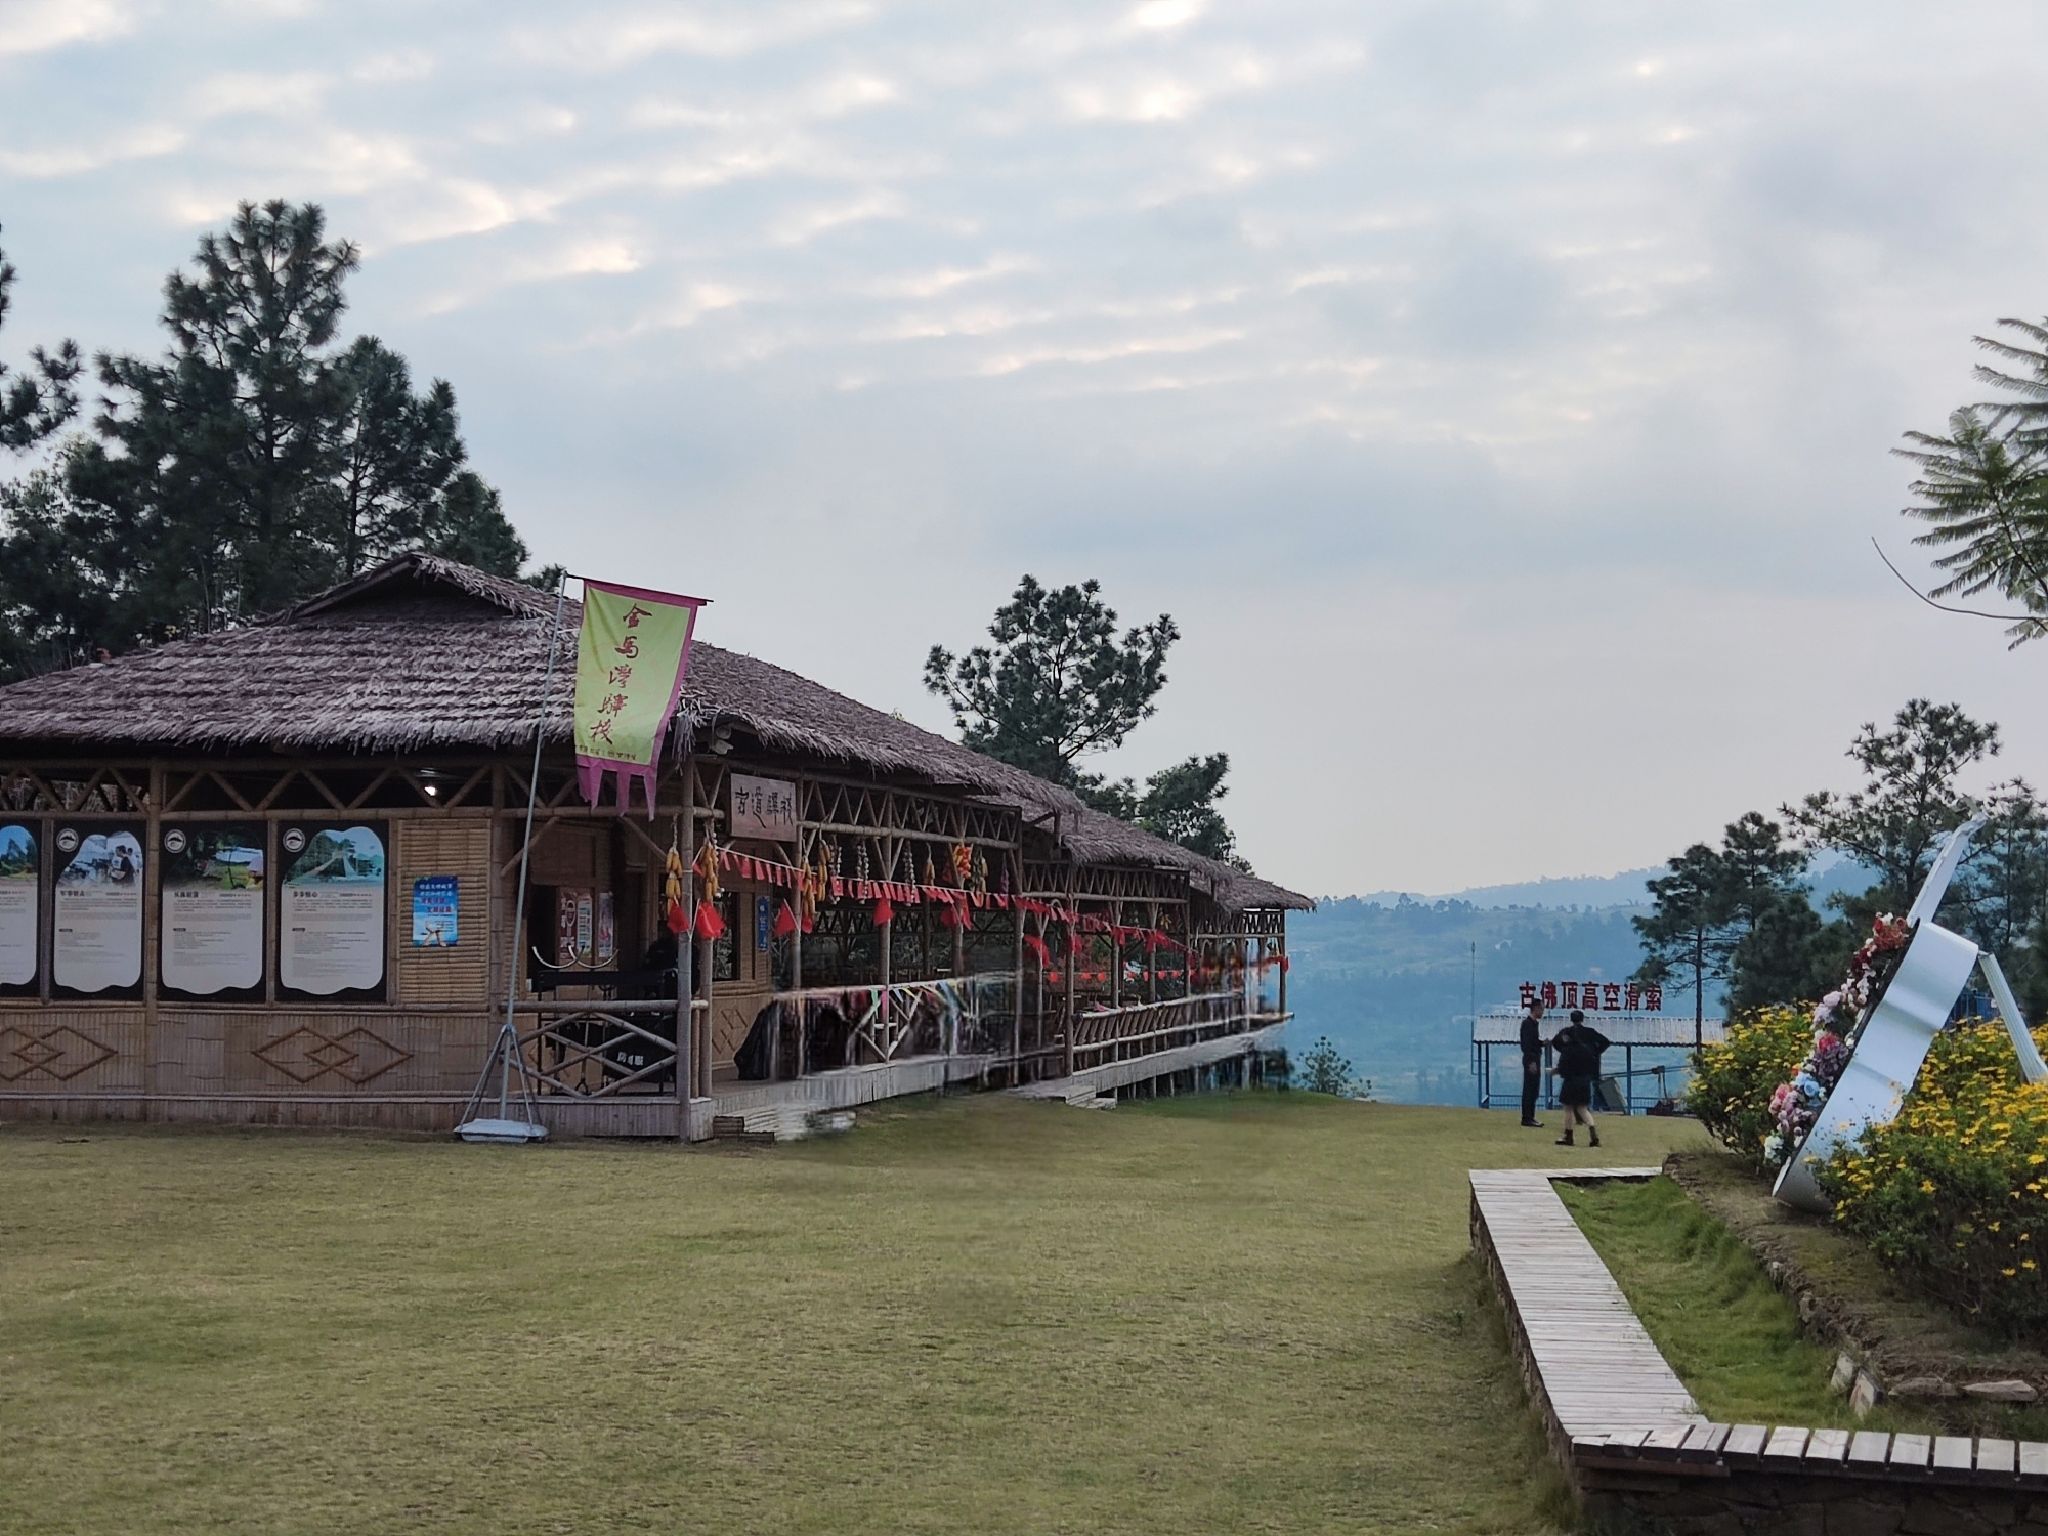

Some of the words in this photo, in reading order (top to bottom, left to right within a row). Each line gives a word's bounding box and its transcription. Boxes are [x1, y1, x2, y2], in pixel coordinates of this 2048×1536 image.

[1519, 981, 1662, 1012] 古佛顶高空滑索
